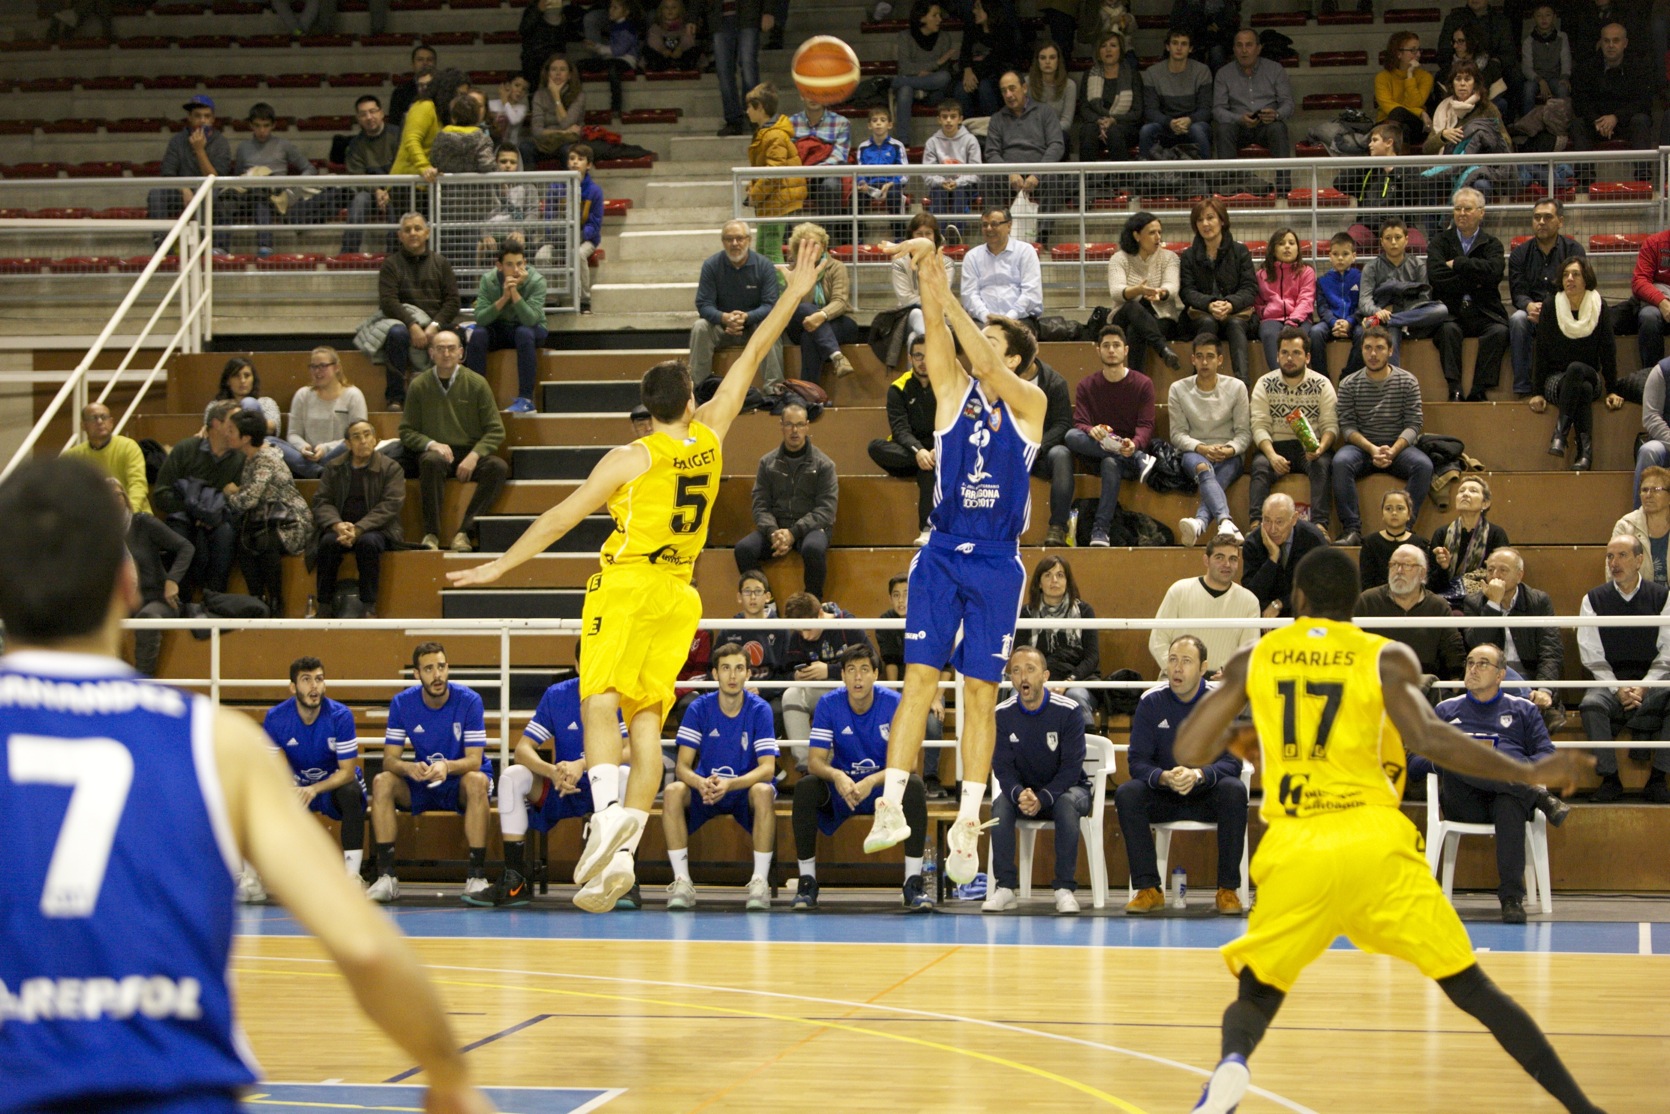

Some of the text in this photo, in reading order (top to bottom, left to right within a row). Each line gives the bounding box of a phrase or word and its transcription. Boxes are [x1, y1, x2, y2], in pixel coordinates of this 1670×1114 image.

[669, 472, 712, 535] 5
[1271, 650, 1356, 666] CHARLES
[1275, 676, 1346, 762] 17
[8, 733, 134, 917] 7
